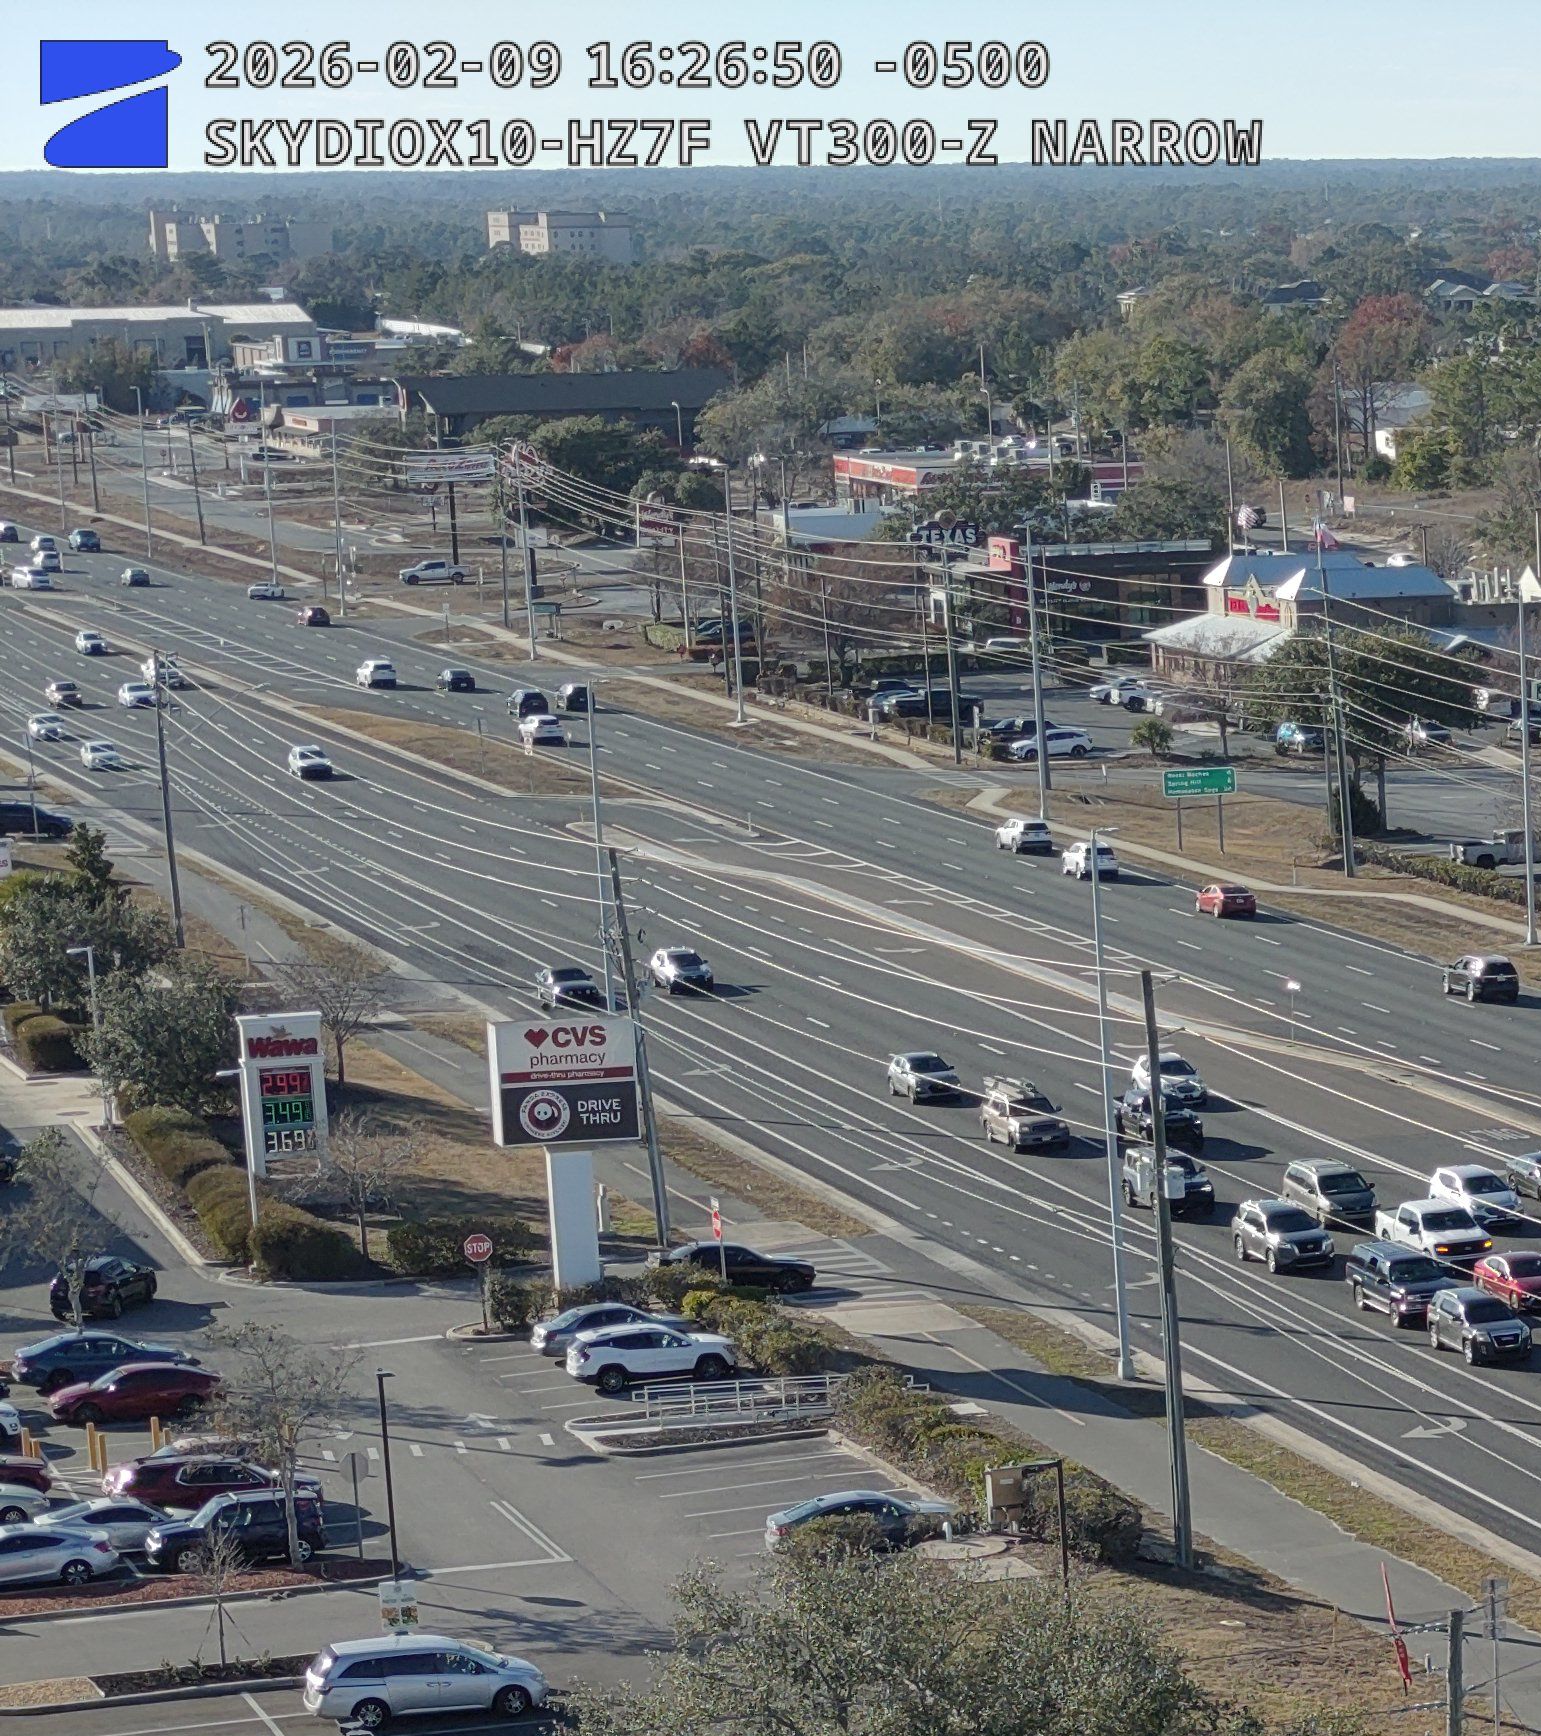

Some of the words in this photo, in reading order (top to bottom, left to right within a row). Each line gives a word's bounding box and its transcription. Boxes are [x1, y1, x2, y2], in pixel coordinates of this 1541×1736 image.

[920, 528, 977, 545] TEXAS
[551, 1025, 607, 1049] CVS
[248, 1036, 318, 1059] Wawa
[530, 1052, 606, 1069] pharmacy
[530, 1072, 567, 1080] drive-thru
[567, 1070, 605, 1079] pharmacy
[577, 1098, 622, 1112] DRIVE
[579, 1111, 621, 1125] THRU
[267, 1130, 306, 1153] 3.69
[466, 1242, 491, 1255] STOP
